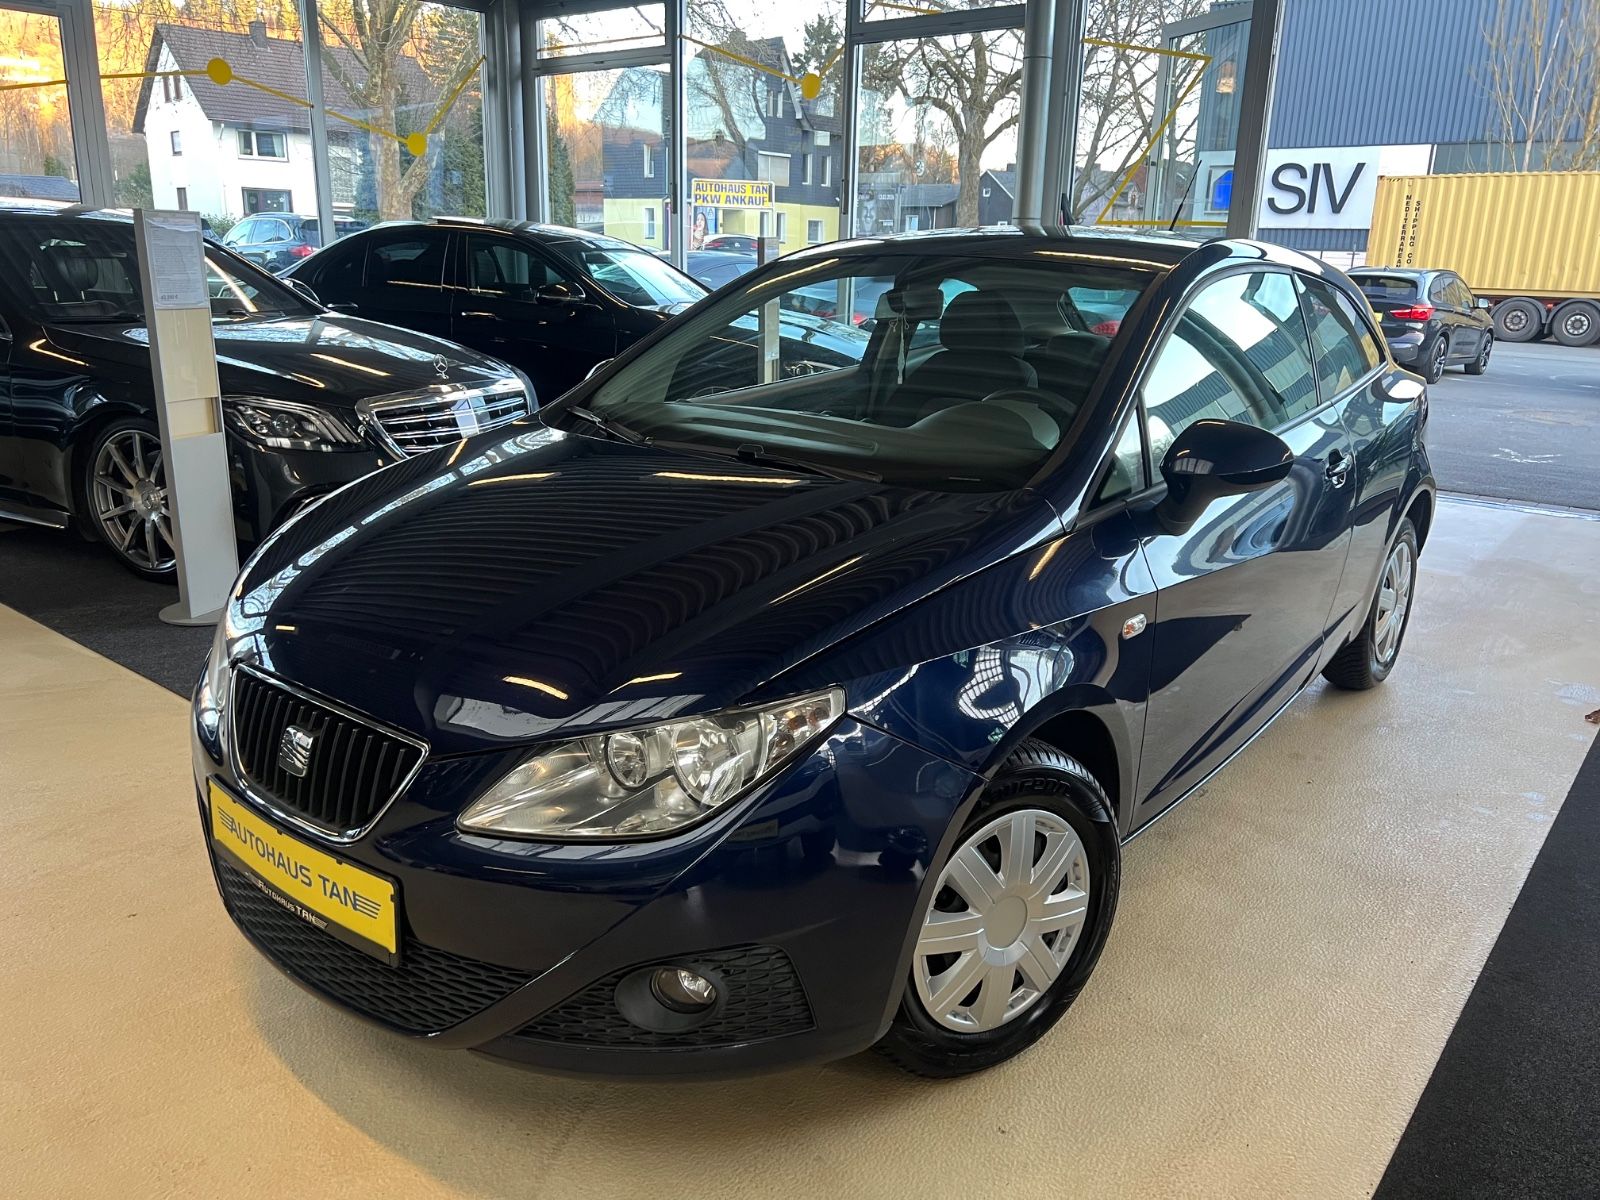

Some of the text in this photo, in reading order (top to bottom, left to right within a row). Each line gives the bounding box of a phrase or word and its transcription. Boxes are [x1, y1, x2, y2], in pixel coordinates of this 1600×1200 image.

[694, 193, 768, 206] PKW ANKAUF
[695, 183, 768, 195] AUTOHAUS TAN
[1267, 162, 1367, 215] SIV
[1406, 200, 1421, 265] SHIPPING CO
[230, 816, 360, 912] AUTOHAUS TAN
[258, 879, 316, 924] AUTOHAUS TAN
